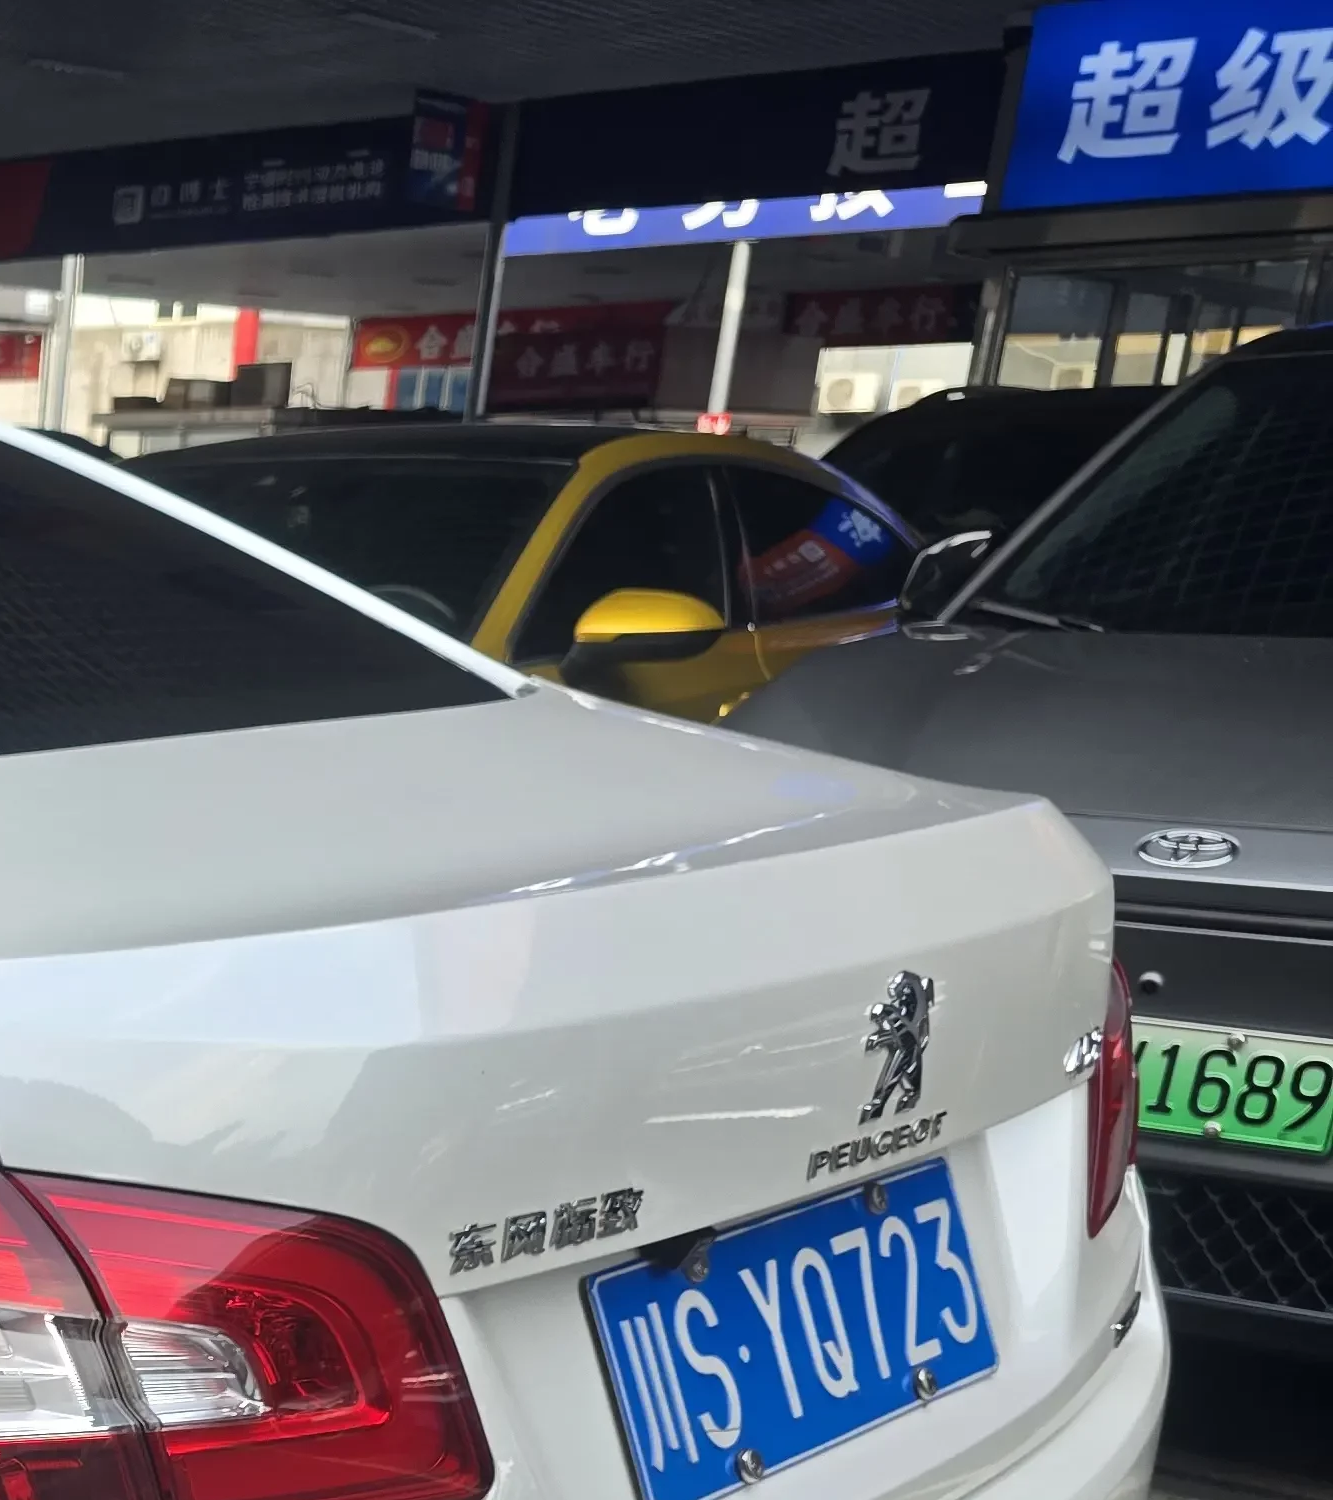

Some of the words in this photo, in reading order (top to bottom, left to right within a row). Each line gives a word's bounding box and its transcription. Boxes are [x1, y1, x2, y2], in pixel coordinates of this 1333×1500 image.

[826, 88, 931, 177] 超
[1056, 27, 1333, 165] 超级
[1134, 1038, 1333, 1134] 1689
[806, 1110, 948, 1181] PEUGEOT
[448, 1187, 645, 1275] 东风标致
